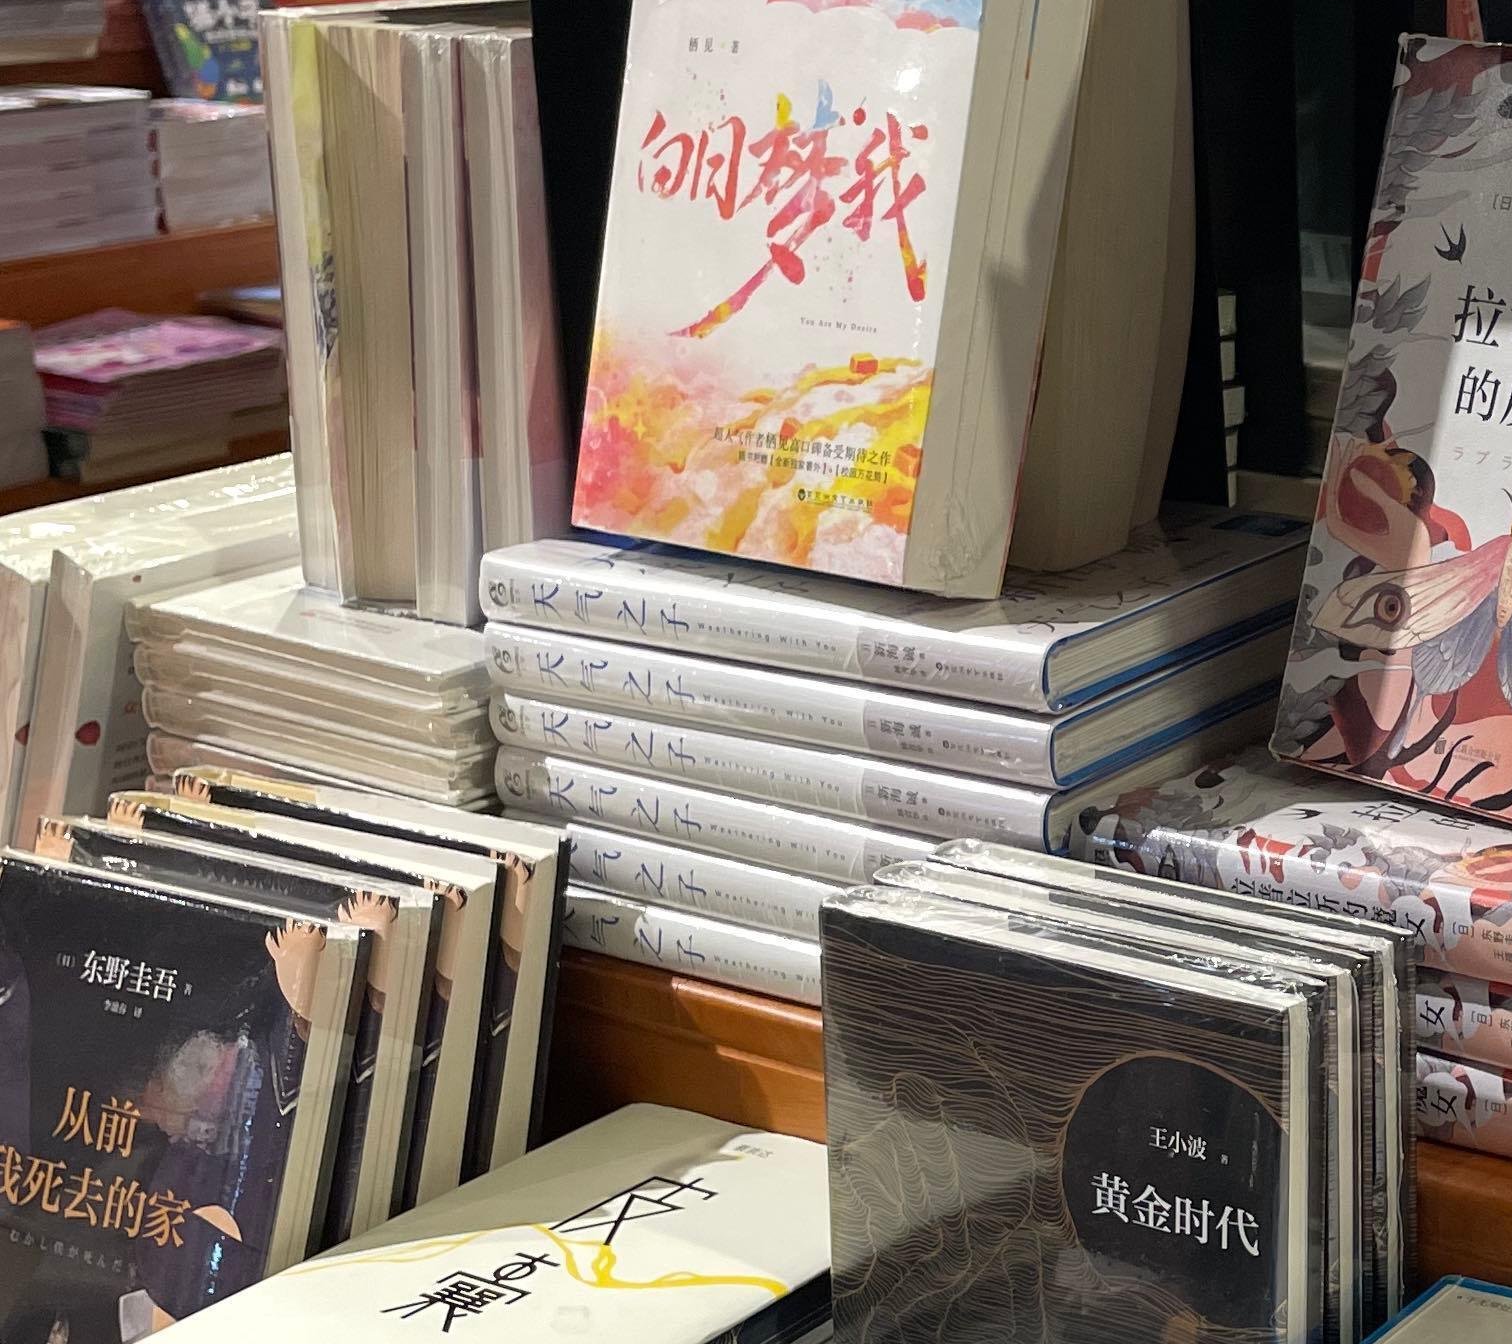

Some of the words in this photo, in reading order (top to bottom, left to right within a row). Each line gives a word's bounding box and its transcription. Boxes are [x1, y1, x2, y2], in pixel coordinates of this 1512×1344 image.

[531, 582, 691, 635] 天气之子
[537, 650, 697, 705] 天气之子
[541, 710, 697, 772] 天气之子
[548, 775, 704, 836] 天气之子
[795, 906, 822, 923] Wit
[80, 950, 178, 1002] 东野圭吾
[794, 970, 822, 986] Wit
[52, 1086, 141, 1158] 从前
[1148, 1126, 1208, 1163] 王小波
[1091, 1171, 1262, 1259] 黄金时代
